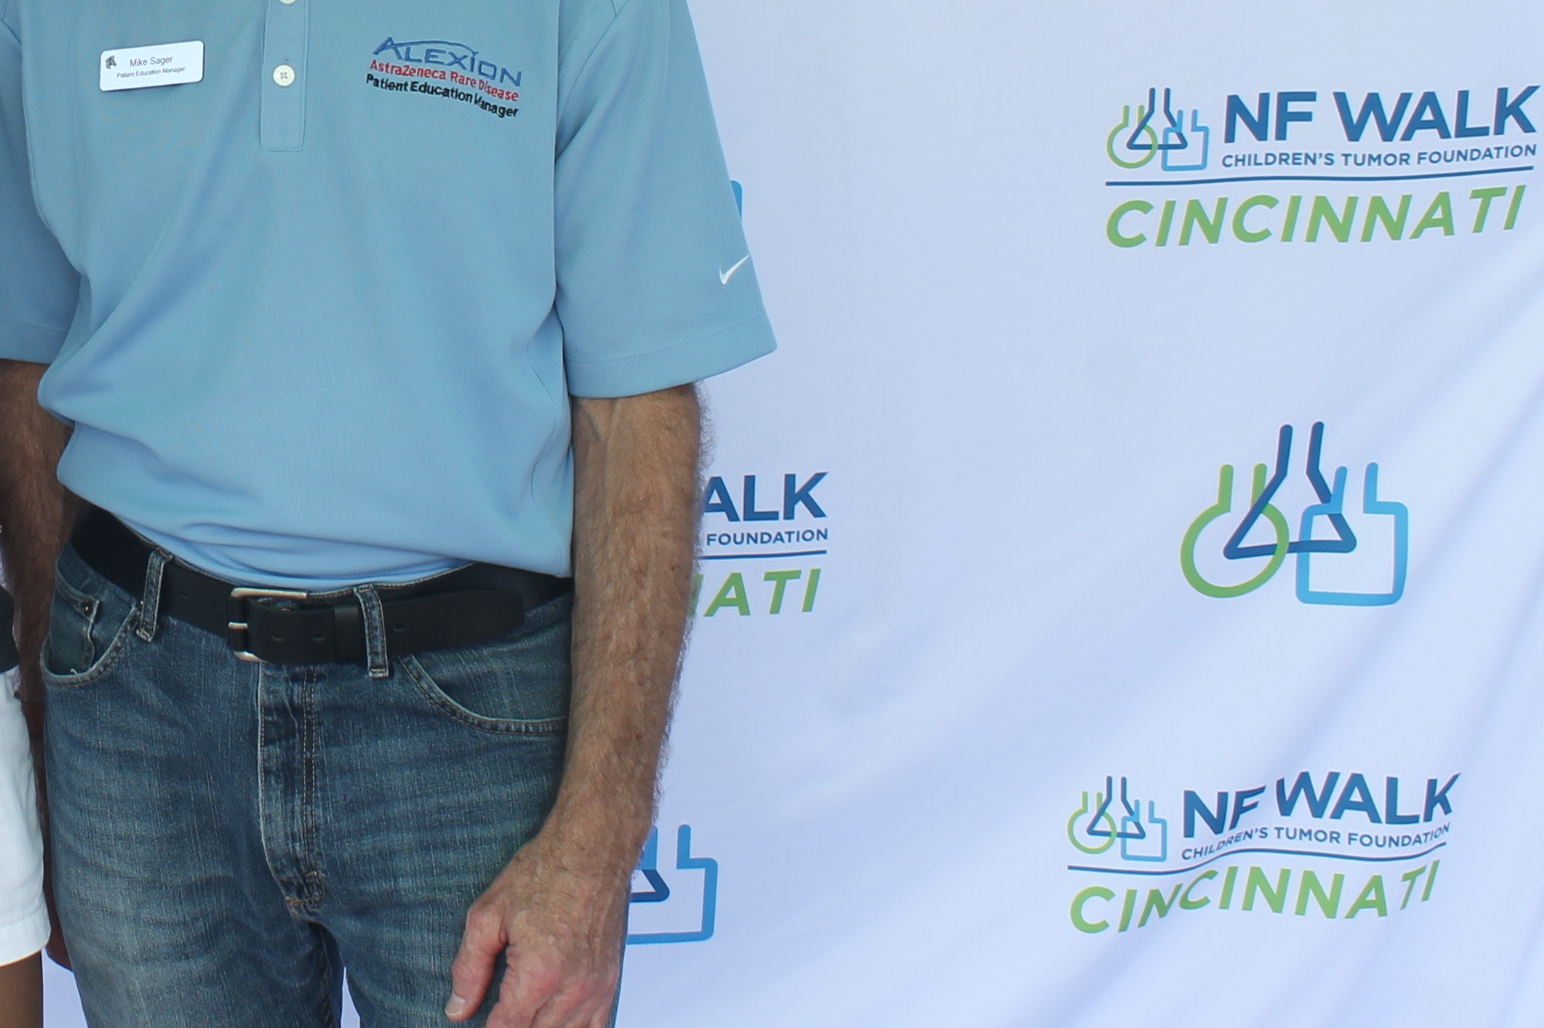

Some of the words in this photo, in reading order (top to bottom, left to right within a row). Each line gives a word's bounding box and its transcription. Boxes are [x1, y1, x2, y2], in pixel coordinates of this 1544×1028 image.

[129, 59, 147, 67] Mike
[150, 56, 173, 66] Sager
[370, 59, 446, 80] AstraZeneca
[450, 70, 477, 88] Rare
[478, 79, 519, 102] Disease
[373, 36, 522, 87] ALEXION
[366, 73, 408, 92] Patient
[410, 80, 473, 103] Education
[474, 93, 519, 118] Manager
[1224, 91, 1317, 144] NF
[1333, 85, 1541, 142] WALK
[1222, 152, 1334, 168] CHILDREN'S
[1341, 152, 1411, 167] TUMOR
[1416, 144, 1537, 165] FOUNDATION
[1106, 184, 1526, 248] CINCINNATI
[703, 472, 828, 522] ALK
[706, 528, 828, 546] FOUNDATION
[1183, 785, 1266, 838] NF
[1275, 771, 1461, 825] WALK
[1181, 827, 1268, 861] CHILDREN'S
[1274, 826, 1341, 845] TUMOR
[1348, 822, 1450, 848] FOUNDATION
[1070, 859, 1440, 934] CINCINNATI
